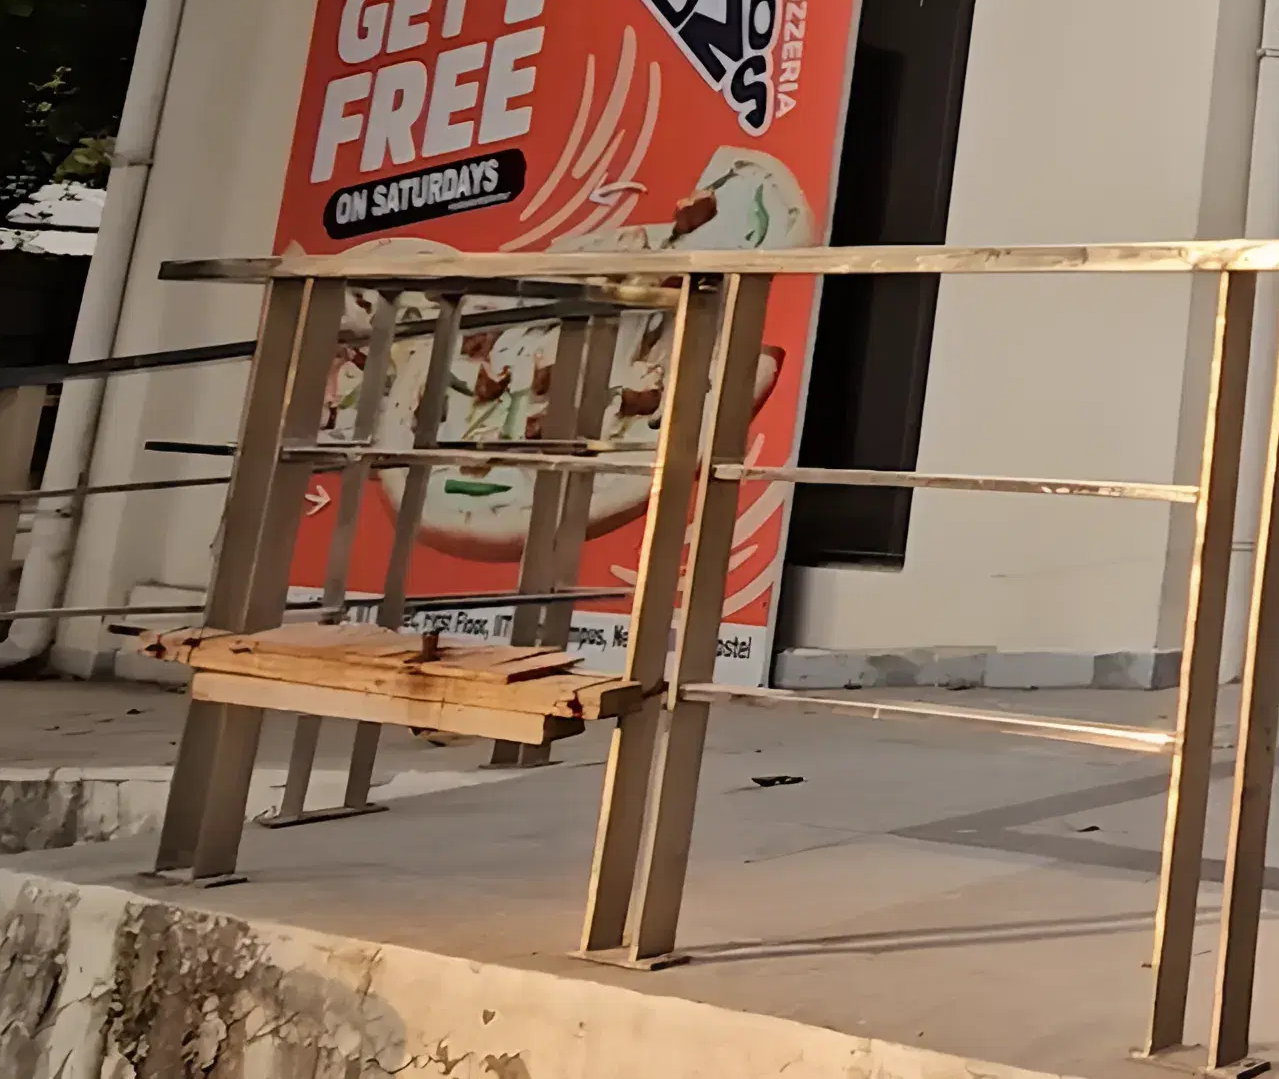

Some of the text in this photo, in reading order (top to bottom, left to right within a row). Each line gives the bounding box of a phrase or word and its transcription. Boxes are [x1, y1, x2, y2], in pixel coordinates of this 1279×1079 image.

[309, 25, 546, 185] FREE
[335, 158, 500, 225] ON SATURDAYS
